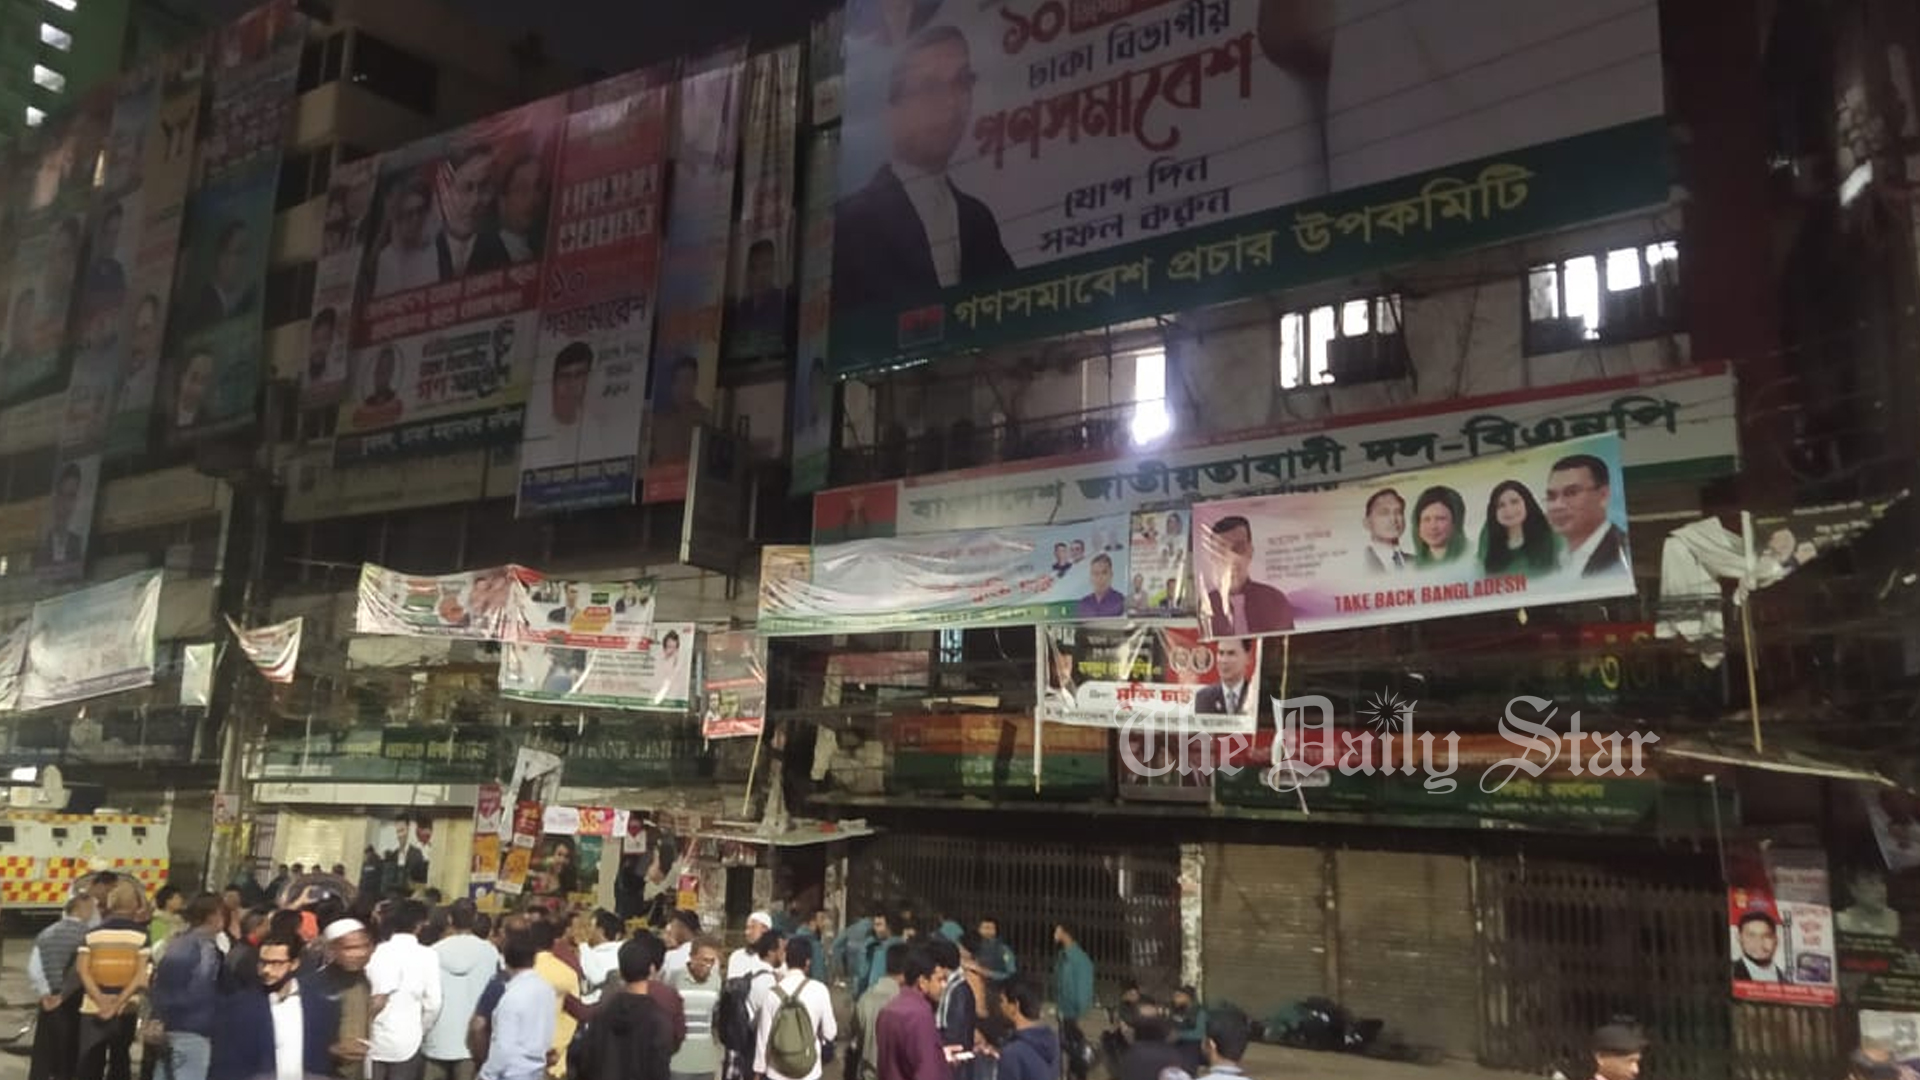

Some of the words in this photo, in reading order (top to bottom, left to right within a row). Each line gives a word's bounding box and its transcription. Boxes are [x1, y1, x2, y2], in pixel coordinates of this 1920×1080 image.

[1000, 0, 1065, 55] ১০
[1027, 44, 1093, 90] ঢাকা
[1107, 0, 1230, 65] বিভাগীয়
[974, 32, 1254, 168] গণসমাবেশ
[1039, 216, 1123, 253] সফল
[1141, 186, 1231, 231] করুন
[1064, 175, 1132, 218] যোগ
[1148, 155, 1208, 194] দিন
[953, 255, 1151, 331] গণসমাবেশ
[1168, 230, 1274, 284] প্রচার
[1293, 164, 1534, 255] উপকমিটি
[1074, 434, 1346, 500] জাতীয়তাবাদী
[1335, 590, 1372, 613] TAKE
[1375, 587, 1416, 610] BACK
[1420, 574, 1528, 606] BANGLADESH
